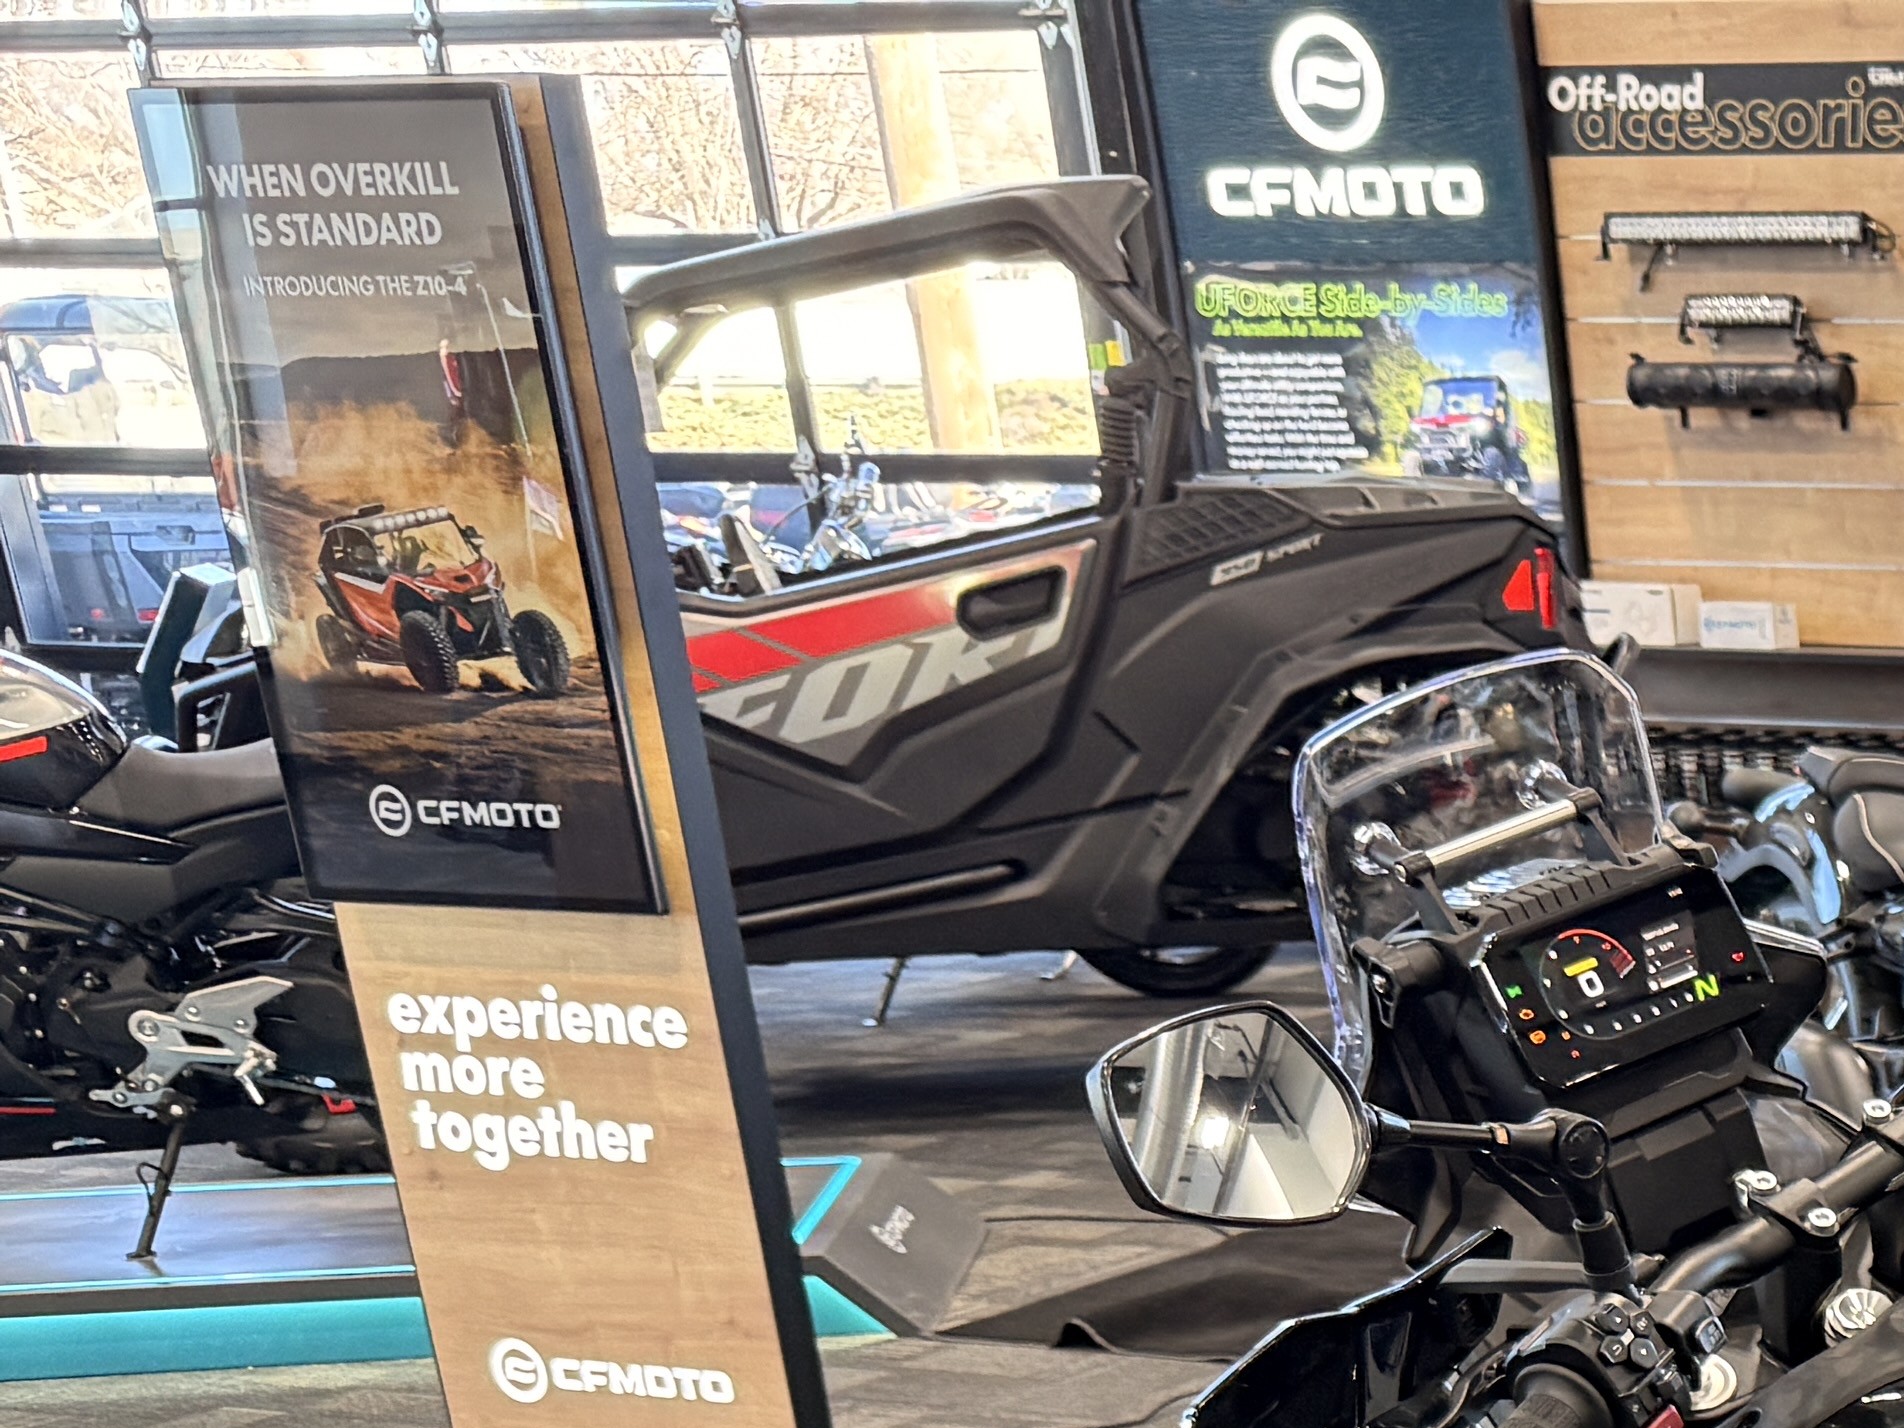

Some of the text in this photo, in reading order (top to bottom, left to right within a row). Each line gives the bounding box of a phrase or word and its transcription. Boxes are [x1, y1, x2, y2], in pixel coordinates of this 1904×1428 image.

[1547, 71, 1705, 112] Off-Road
[206, 161, 460, 198] WHEN OVERKILL
[1207, 165, 1486, 217] CFMOTO
[242, 212, 443, 247] IS STANDARD
[243, 274, 467, 297] INTRODUCING THE Z10-4
[1195, 281, 1509, 326] UFORCE Side-by-Sides
[418, 799, 561, 830] CFMOTO
[1693, 972, 1721, 1002] N
[387, 983, 690, 1054] experience
[399, 1046, 546, 1100] more
[409, 1098, 655, 1173] together
[550, 1356, 736, 1405] CFMOTO
